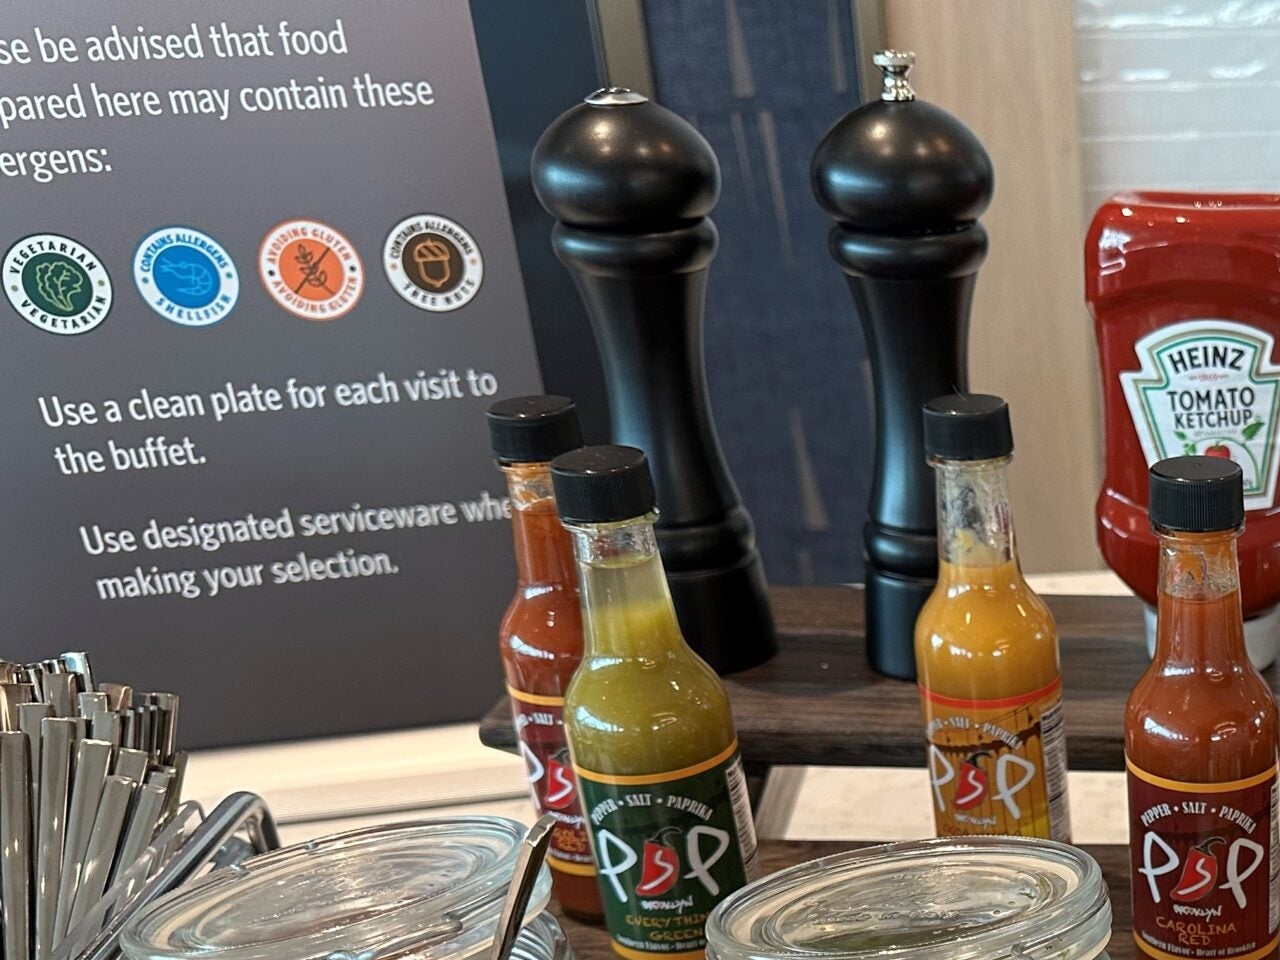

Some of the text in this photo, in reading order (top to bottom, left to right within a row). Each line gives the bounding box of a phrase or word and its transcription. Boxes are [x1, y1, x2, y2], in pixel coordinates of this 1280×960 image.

[34, 27, 79, 63] be
[85, 18, 204, 62] advised
[209, 22, 273, 59] that
[278, 18, 348, 56] food
[90, 82, 161, 117] here
[168, 88, 231, 121] may
[239, 76, 348, 111] contain
[352, 72, 434, 107] these
[10, 241, 97, 274] VEGETARIAN
[140, 233, 228, 272] CONTAINS ALLERGENS
[266, 227, 351, 263] AVOIDING GLUTEN
[21, 295, 107, 330] VEGETARIAN
[157, 294, 232, 321] SHELLFISH
[1168, 346, 1246, 374] HEINZ
[38, 368, 498, 429] Use a clean plate for each visit to
[1166, 387, 1255, 412] TOMATO
[1174, 409, 1254, 429] KETCHUP
[55, 436, 206, 476] the buffet.
[79, 489, 513, 557] Use designated serviceware whe
[96, 547, 399, 600] making your selection.
[625, 793, 652, 807] SALT
[667, 795, 714, 821] PAPRIKA
[1140, 802, 1257, 834] PEPPER SALT PAPRIKA
[626, 911, 708, 927] EVERYTHIN
[650, 928, 704, 941] GREEN
[1156, 916, 1237, 935] CAROLINA
[1178, 933, 1211, 945] RED
